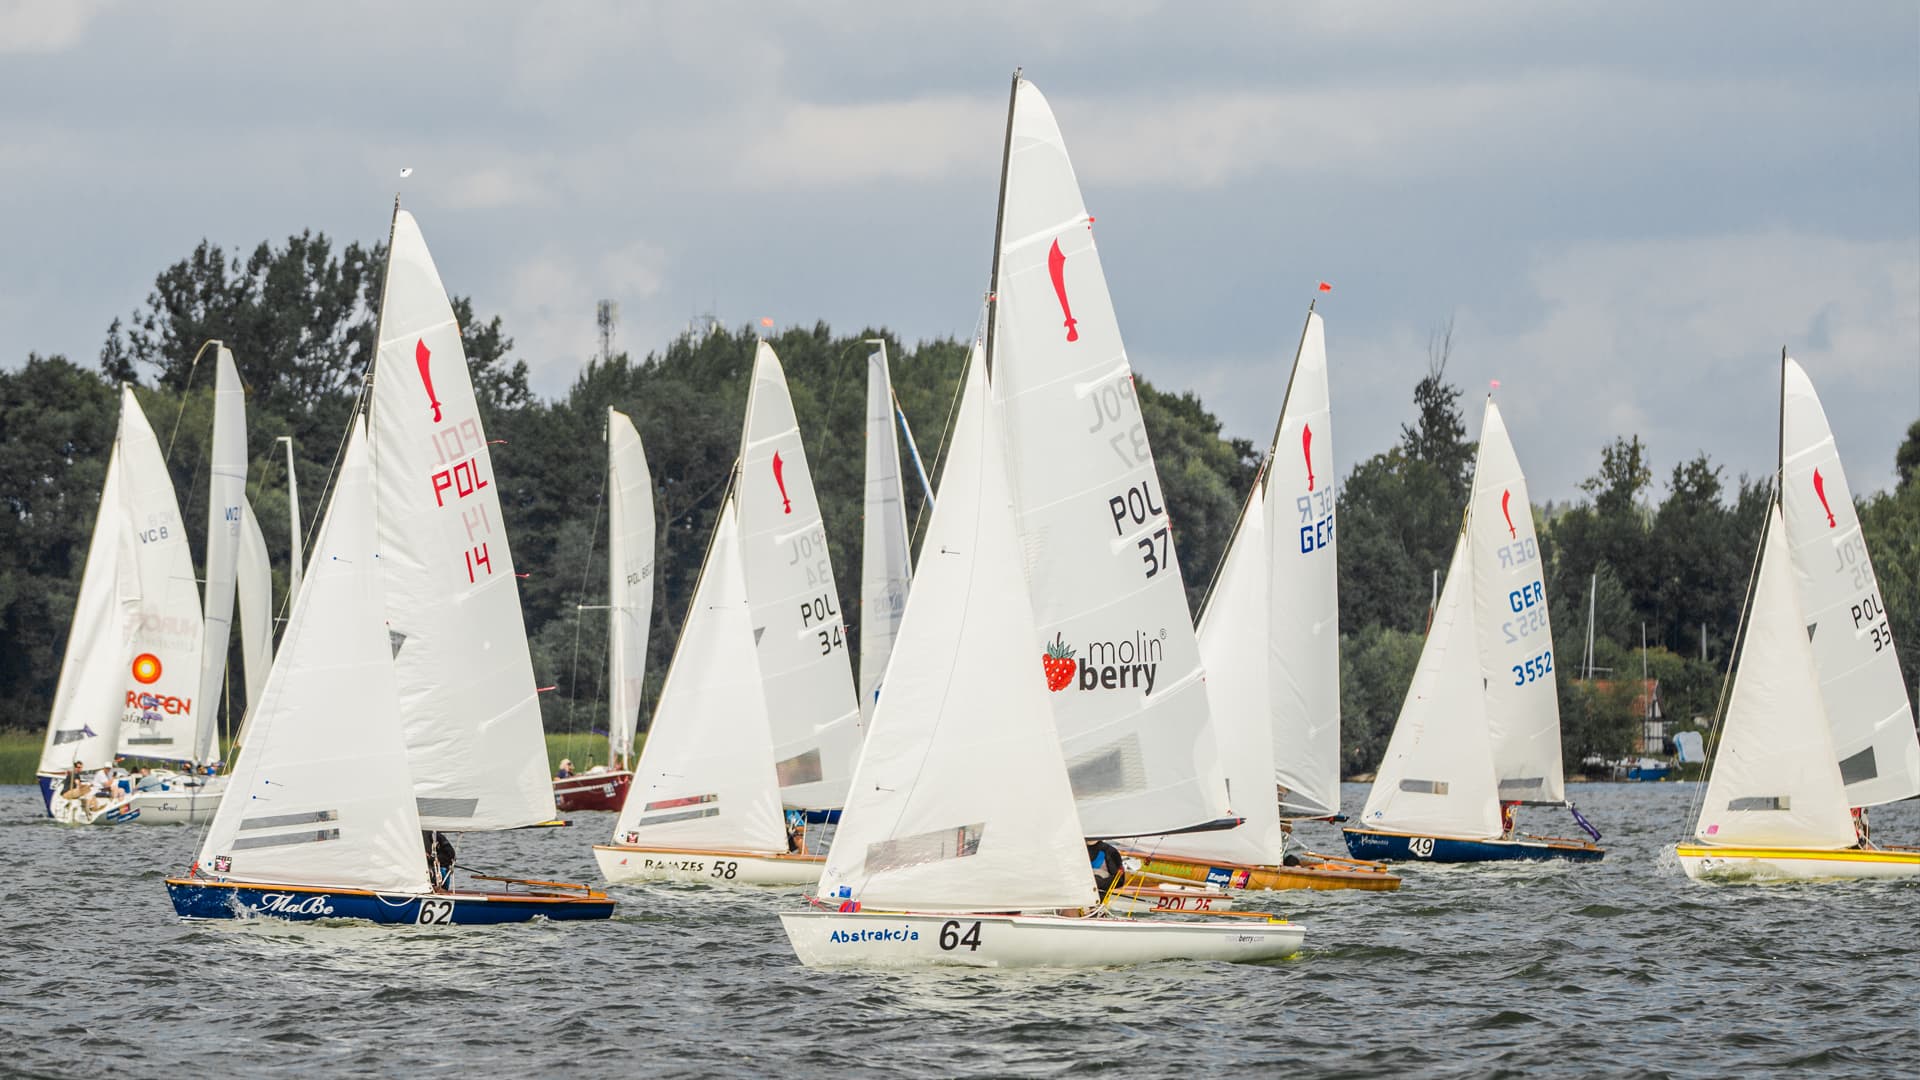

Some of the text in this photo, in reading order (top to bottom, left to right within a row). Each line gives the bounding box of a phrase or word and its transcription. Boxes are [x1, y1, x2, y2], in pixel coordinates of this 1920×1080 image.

[431, 457, 488, 507] POL
[1109, 481, 1162, 536] POL
[139, 528, 158, 544] VC
[1300, 514, 1333, 554] GER
[465, 542, 491, 583] 14
[1138, 527, 1168, 579] 37
[800, 594, 837, 628] POL
[1509, 580, 1544, 613] GER
[1851, 594, 1883, 629] POL
[818, 625, 843, 656] 34
[1870, 621, 1891, 652] 35
[1079, 658, 1157, 696] berry
[1512, 651, 1552, 686] 3552
[1410, 838, 1433, 855] 19
[711, 860, 738, 880] 58
[251, 893, 334, 915] MaBe
[419, 900, 452, 926] 62
[830, 925, 919, 943] Abstrakcja
[939, 919, 982, 951] 64
